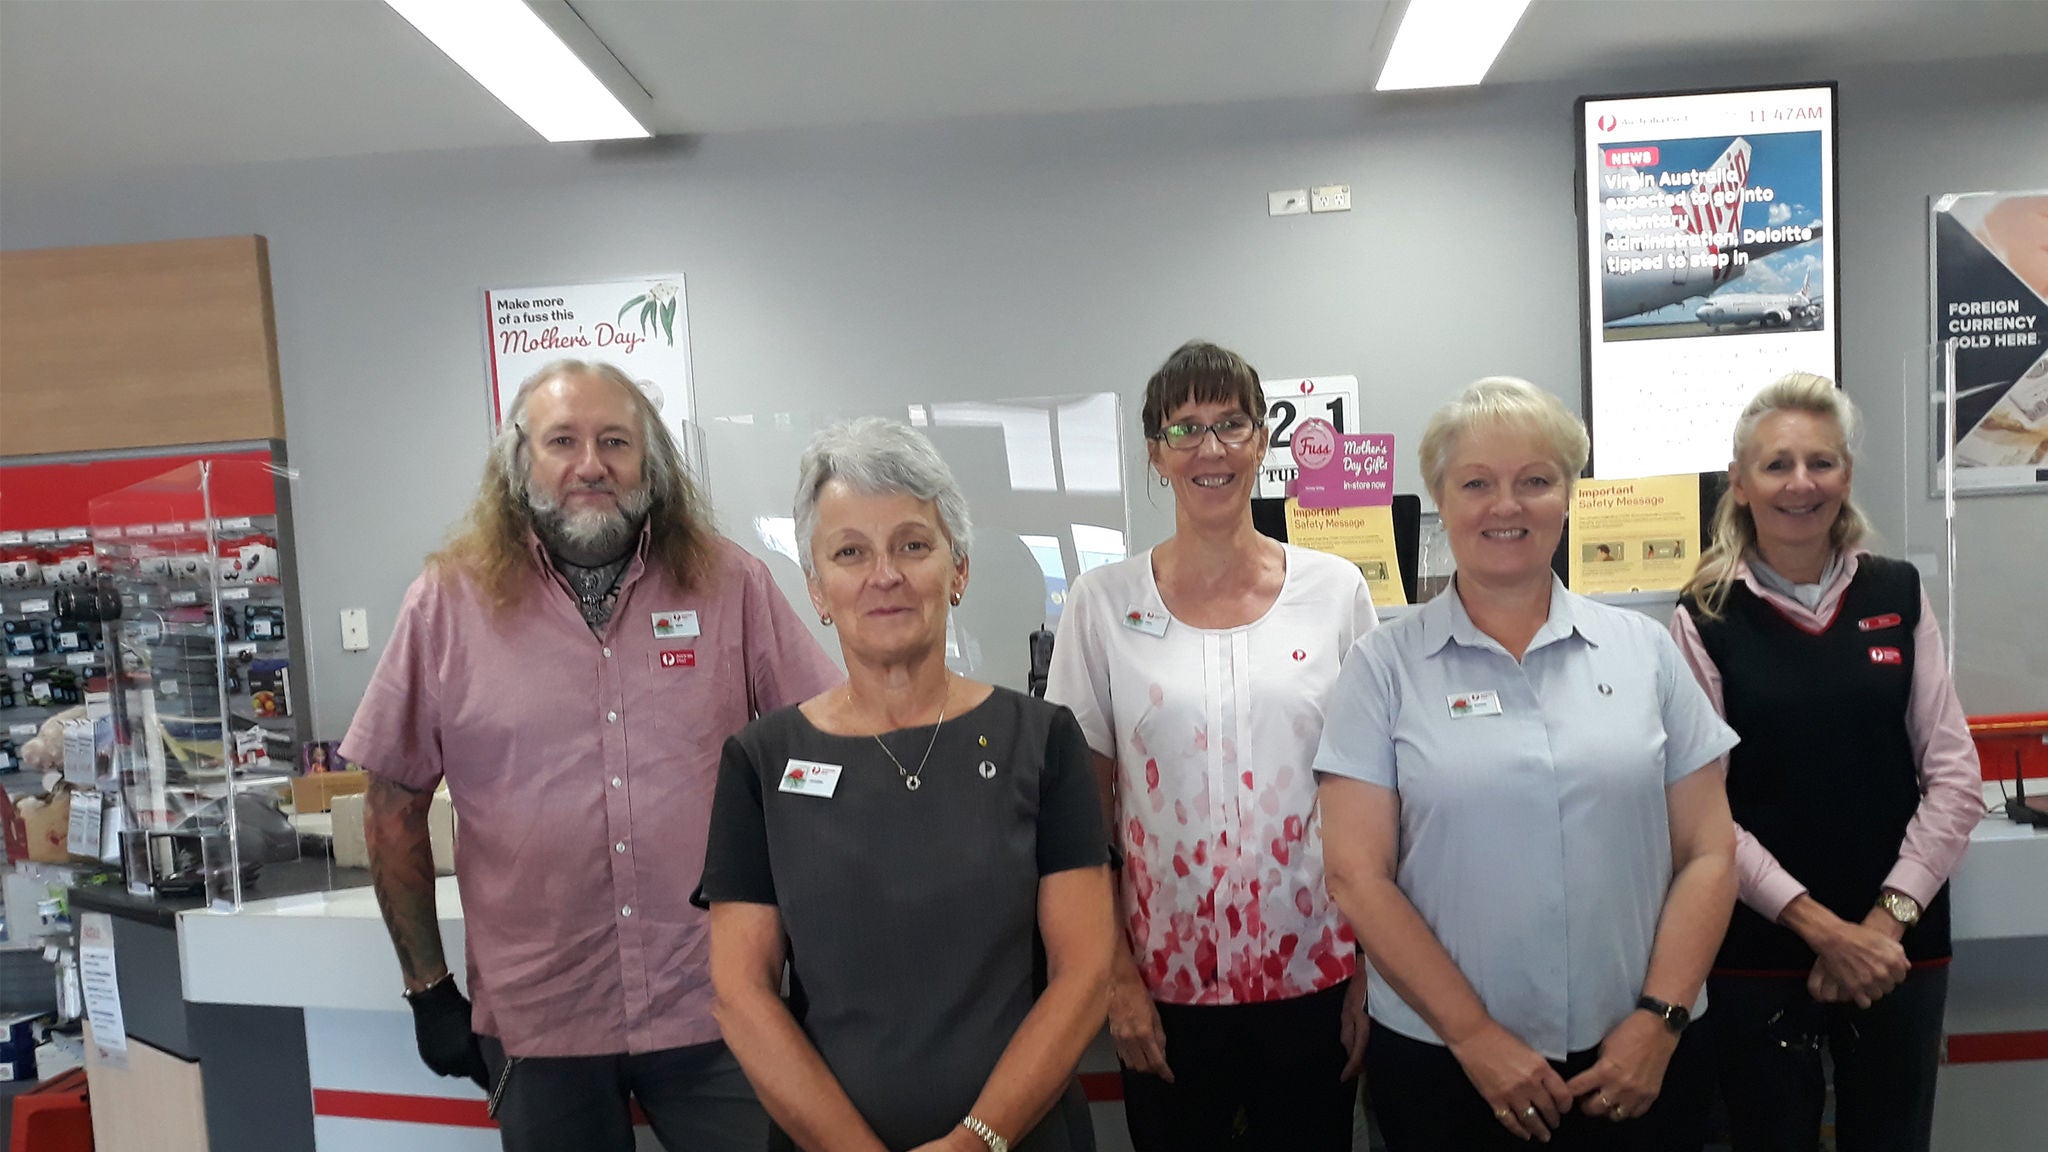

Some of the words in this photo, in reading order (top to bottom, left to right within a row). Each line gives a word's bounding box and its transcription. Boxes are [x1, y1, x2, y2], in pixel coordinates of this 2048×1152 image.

[1750, 106, 1822, 122] 1147AM
[1611, 151, 1652, 165] NEWS
[1604, 172, 1656, 191] Virgin
[1659, 167, 1738, 187] Australia
[1605, 190, 1687, 212] expected
[1690, 189, 1710, 206] to
[1713, 190, 1736, 208] go
[1740, 186, 1775, 203] into
[1606, 213, 1689, 231] voluntary
[1606, 230, 1739, 252] administration,
[1743, 225, 1813, 244] Deloitte
[1606, 253, 1663, 275] tipped
[1666, 252, 1687, 269] to
[1690, 250, 1730, 270] step
[1733, 249, 1750, 267] in
[497, 298, 530, 311] Make
[532, 297, 564, 309] more
[1949, 300, 2020, 316] FOREIGN
[498, 313, 510, 325] of
[513, 315, 521, 324] a
[523, 311, 549, 323] fuss
[550, 309, 574, 321] this
[1949, 315, 2037, 333] CURRENCY
[500, 326, 591, 354] Mother's
[1298, 436, 1332, 456] Fuss
[1343, 439, 1387, 456] Mother's
[1342, 456, 1362, 477] Day
[1364, 455, 1388, 476] Gifts
[1371, 481, 1386, 489] now
[1579, 485, 1634, 499] Important
[1579, 499, 1614, 509] Safety
[1616, 496, 1664, 507] Message
[1293, 507, 1340, 518] Important
[1294, 519, 1324, 530] Safety
[1326, 518, 1365, 529] Message
